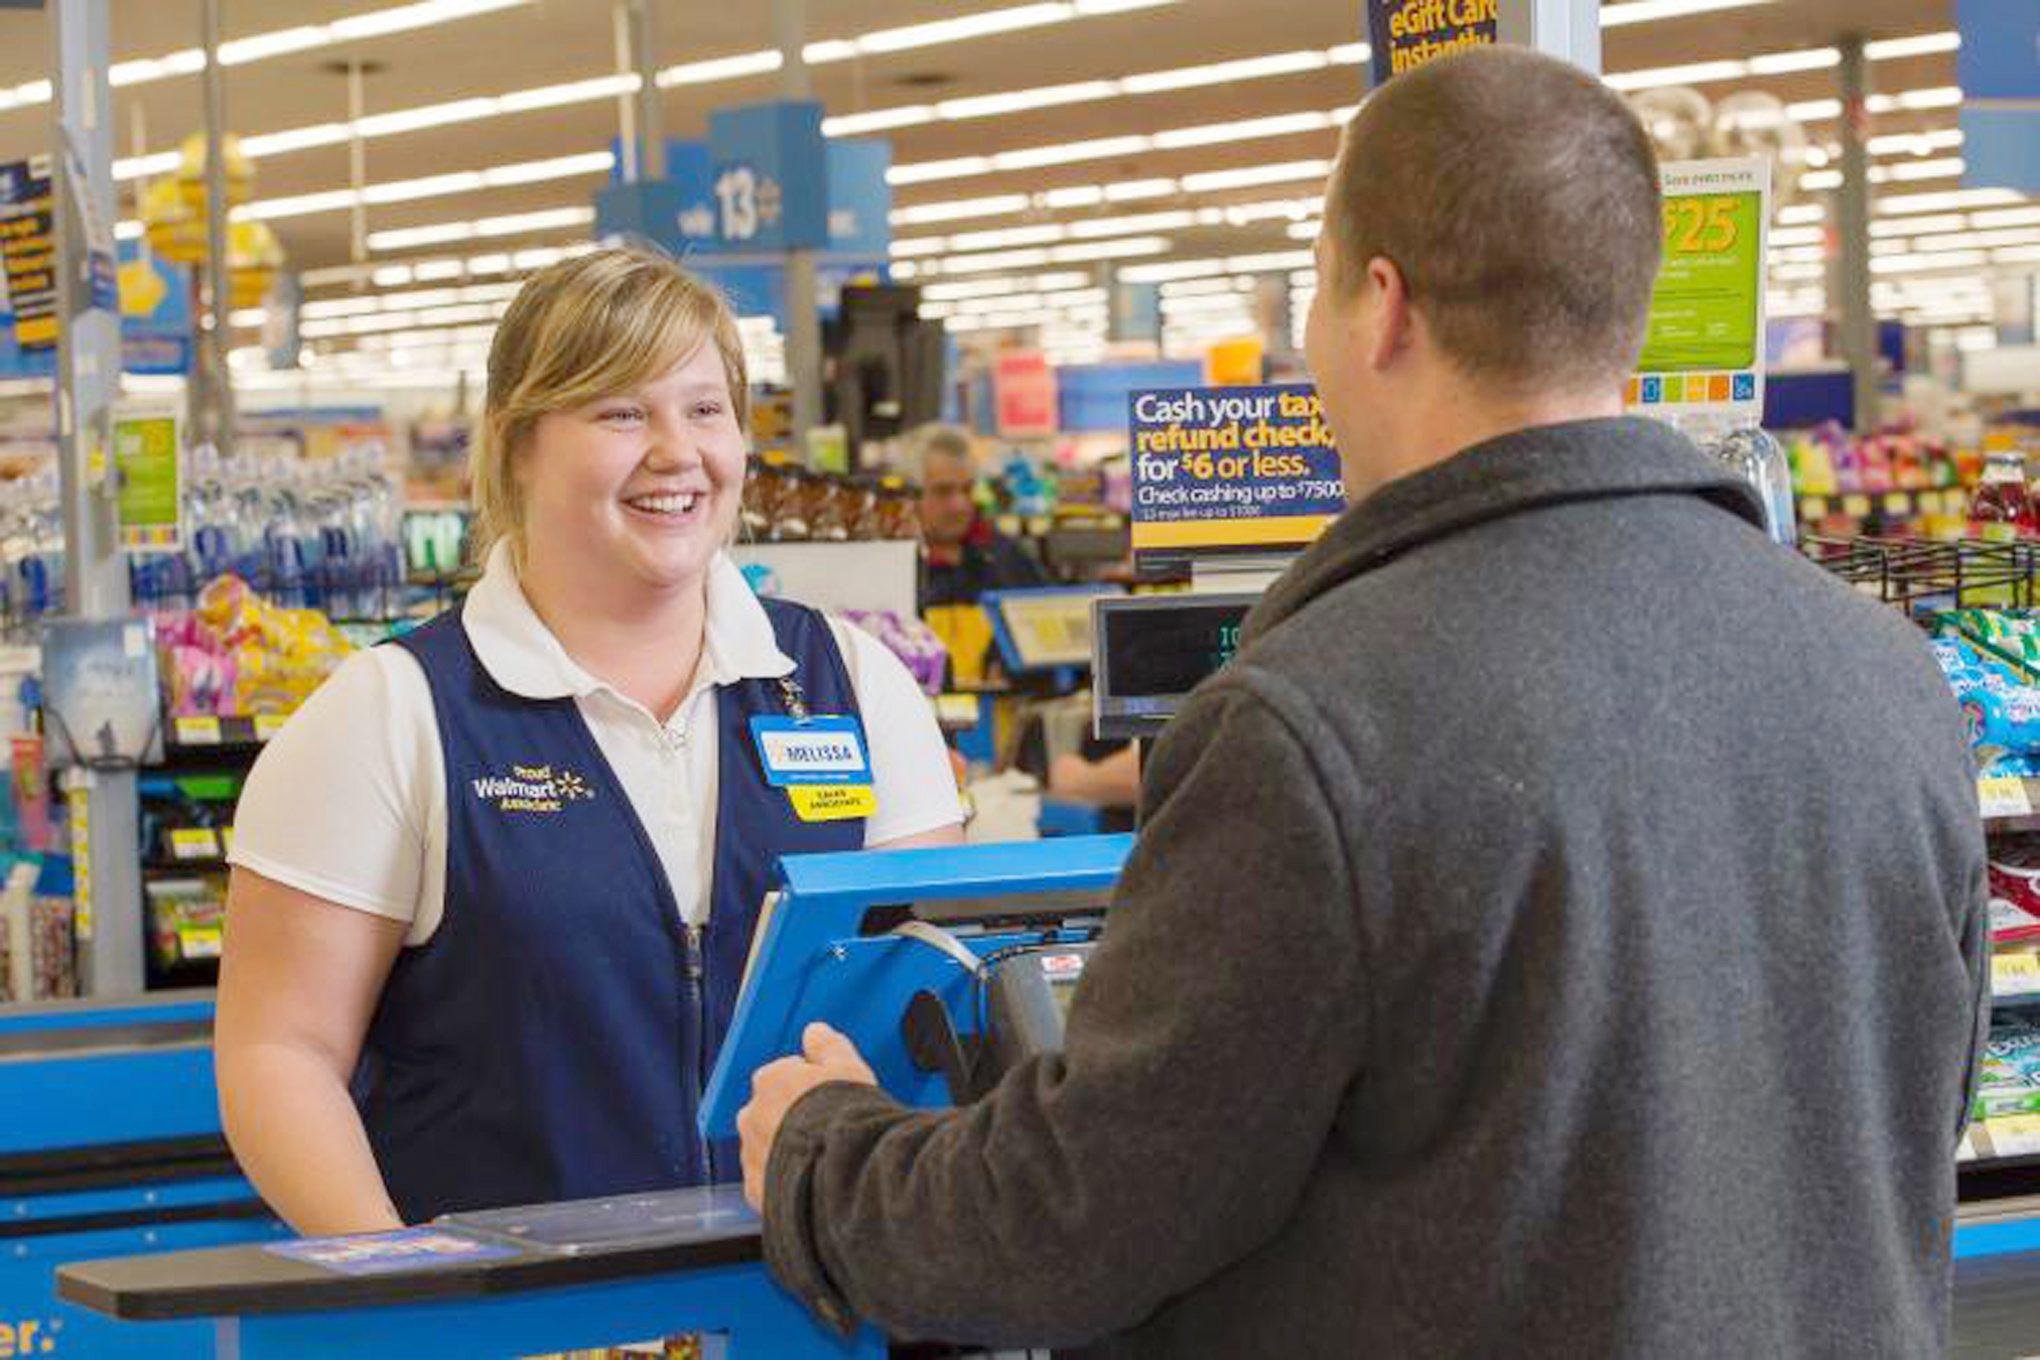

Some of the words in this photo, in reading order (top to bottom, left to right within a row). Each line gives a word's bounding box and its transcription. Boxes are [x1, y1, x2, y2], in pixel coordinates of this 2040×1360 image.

[1135, 391, 1205, 424] Cash
[1208, 394, 1275, 428] your
[1278, 392, 1324, 419] tax
[1137, 420, 1240, 453] refund
[1137, 453, 1180, 482] for
[1181, 451, 1214, 480] $6
[1217, 455, 1250, 479] or
[1252, 449, 1311, 477] less.
[1138, 486, 1191, 505] Check
[1190, 481, 1252, 504] cashing
[1254, 485, 1277, 502] up
[1278, 483, 1297, 499] to
[785, 745, 852, 762] MELISSA
[473, 776, 559, 799] Walmart
